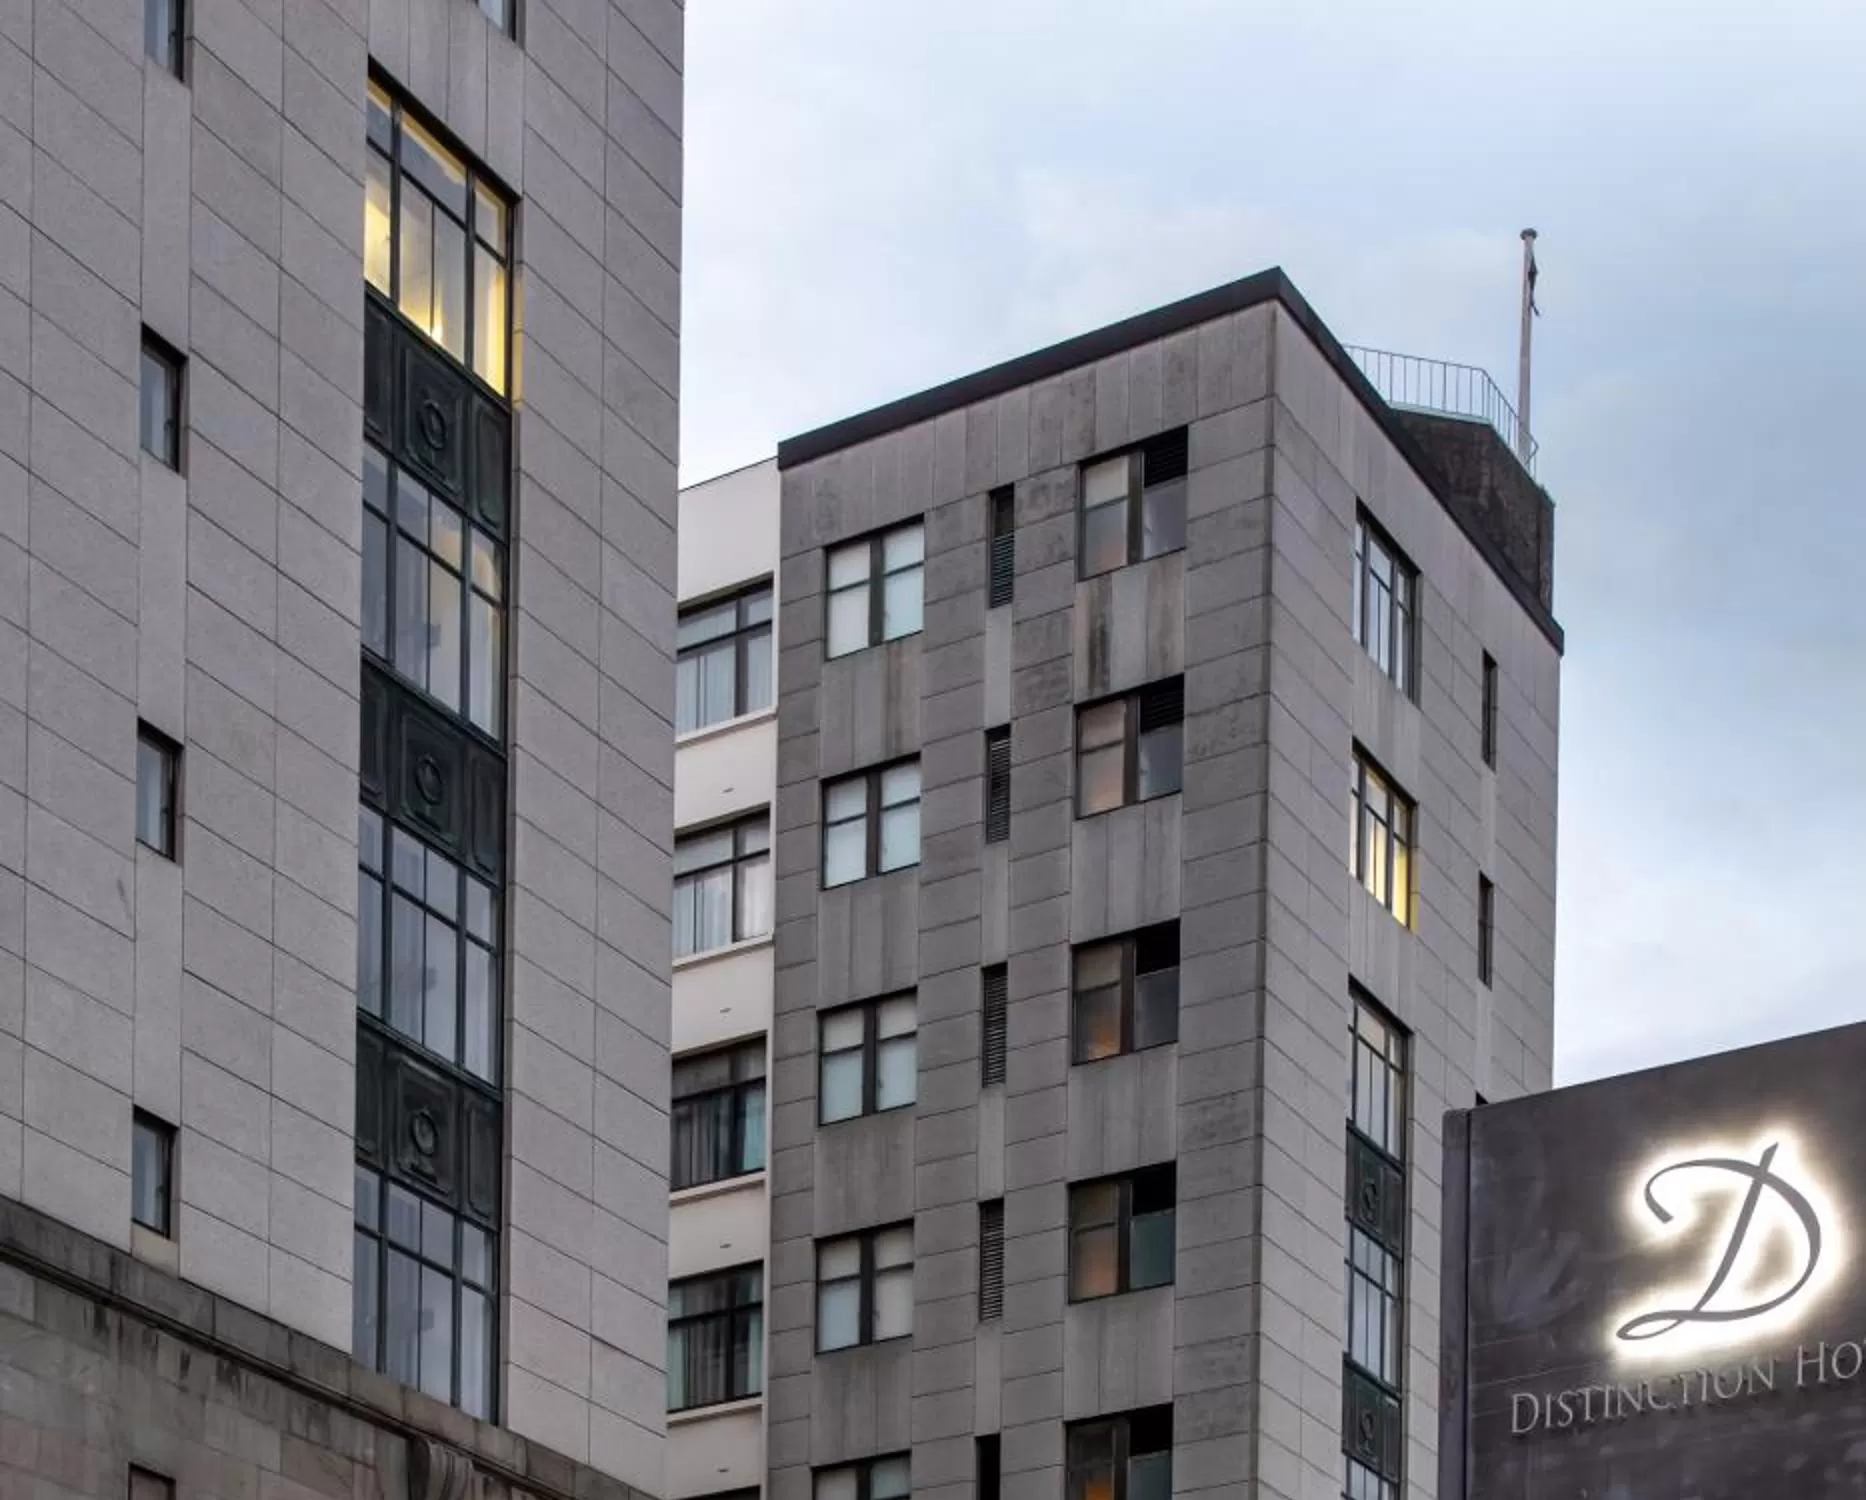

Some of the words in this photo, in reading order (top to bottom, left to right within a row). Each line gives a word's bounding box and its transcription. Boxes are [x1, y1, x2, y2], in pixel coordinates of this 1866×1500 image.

[1615, 1142, 1821, 1341] D
[1511, 1356, 1776, 1434] DISTINCTION
[1796, 1337, 1866, 1387] HO
